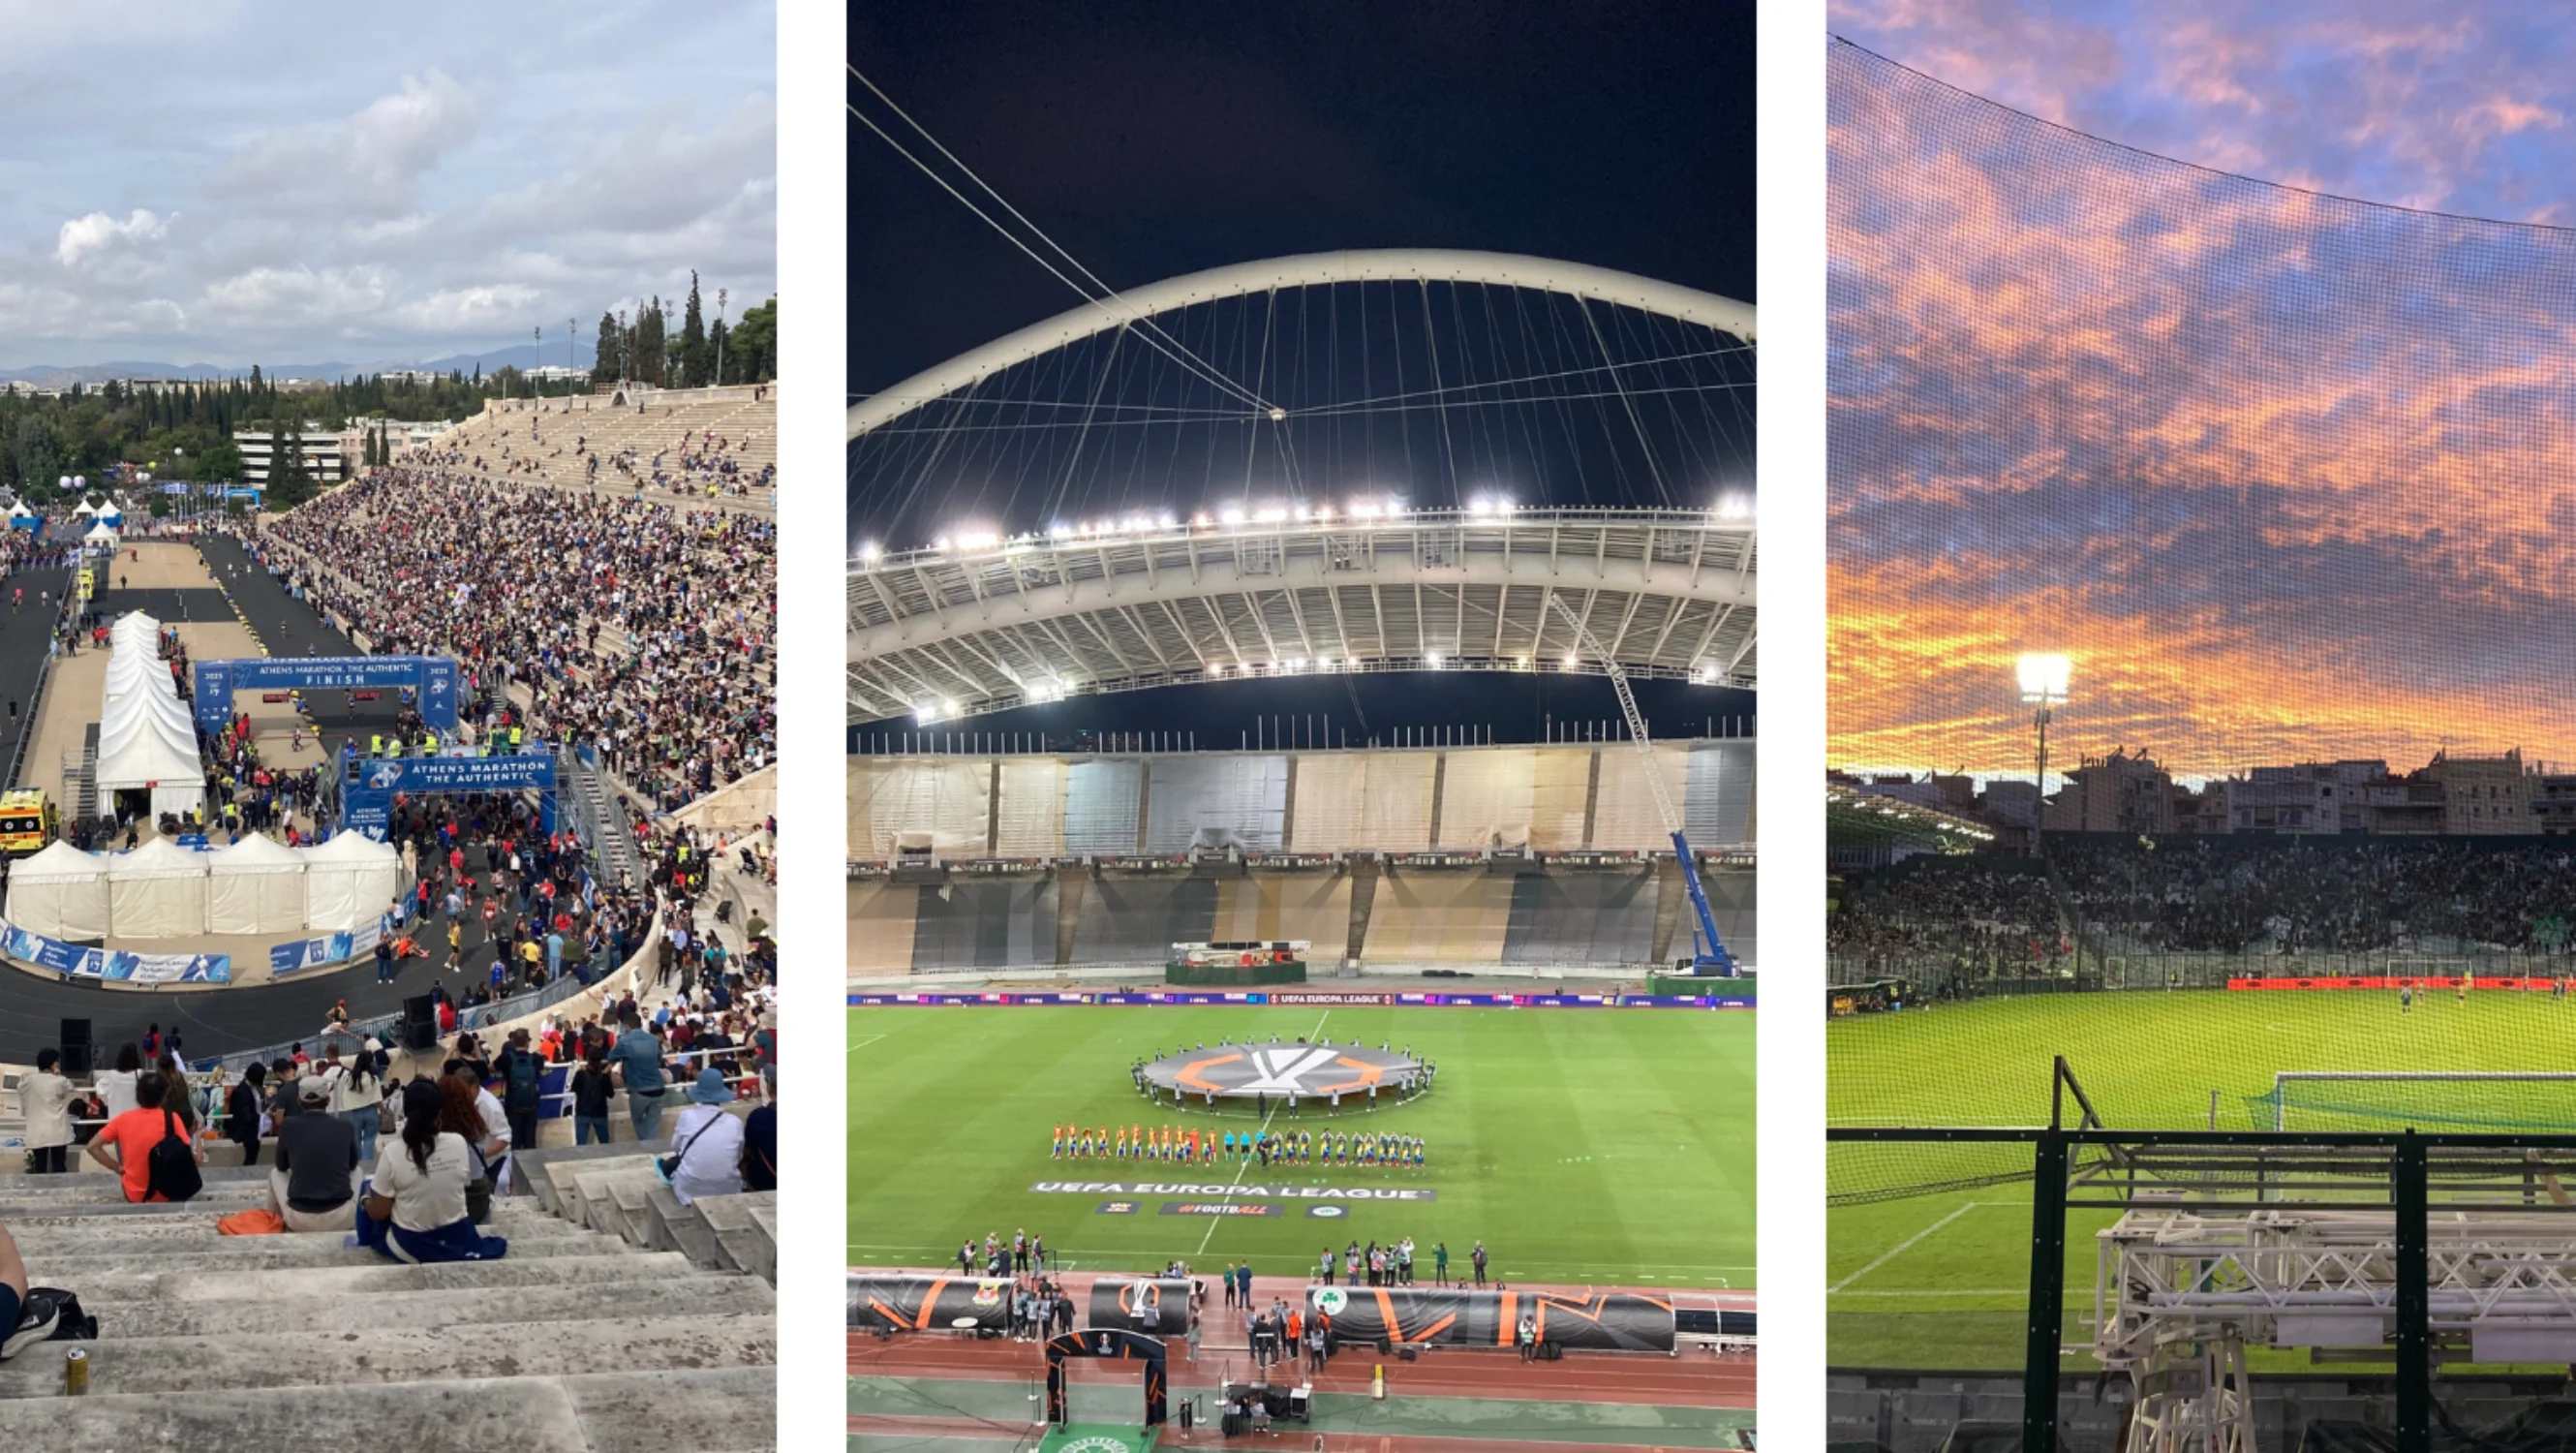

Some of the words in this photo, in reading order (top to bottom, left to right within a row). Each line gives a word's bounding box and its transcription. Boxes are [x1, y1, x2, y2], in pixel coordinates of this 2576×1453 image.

[260, 665, 292, 675] ATHENS
[348, 665, 364, 673] THE
[365, 664, 414, 673] AUTHENTIC
[306, 675, 364, 686] FINISH
[413, 764, 465, 774] ATHENS
[471, 761, 546, 773] MARATHON
[426, 775, 449, 784] THE
[457, 772, 533, 783] AUTHENTIC
[1281, 995, 1306, 1004] UEFA
[1306, 995, 1342, 1004] EUROPA
[1344, 995, 1380, 1004] LEAGUE
[1035, 1182, 1123, 1192] UEFA
[1133, 1183, 1269, 1195] EUROPA
[1178, 1203, 1268, 1215] #FOOTBALL
